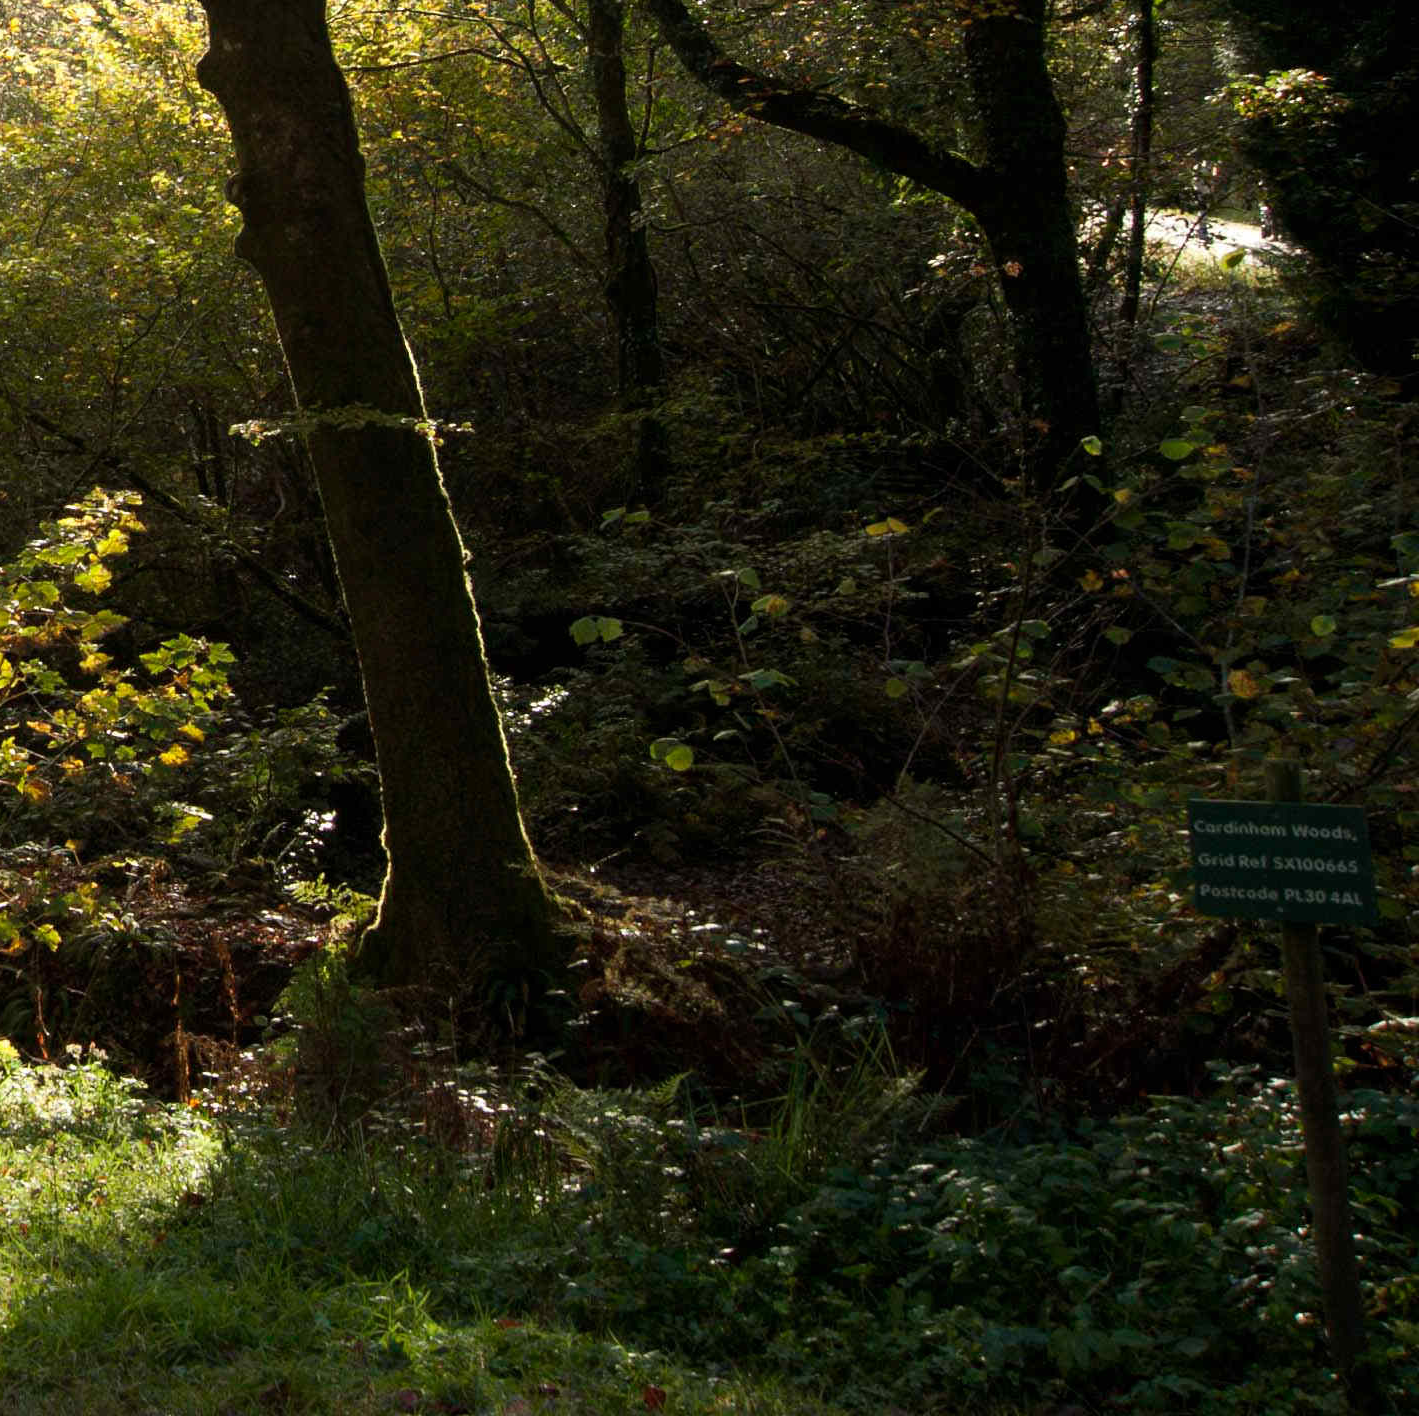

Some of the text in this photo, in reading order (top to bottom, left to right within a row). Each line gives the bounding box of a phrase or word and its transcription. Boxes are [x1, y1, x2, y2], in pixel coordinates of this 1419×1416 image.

[1194, 820, 1287, 837] Cardinham
[1198, 853, 1358, 874] Grid Ref SX100665
[1200, 884, 1363, 906] Postcode PL30 4AL
